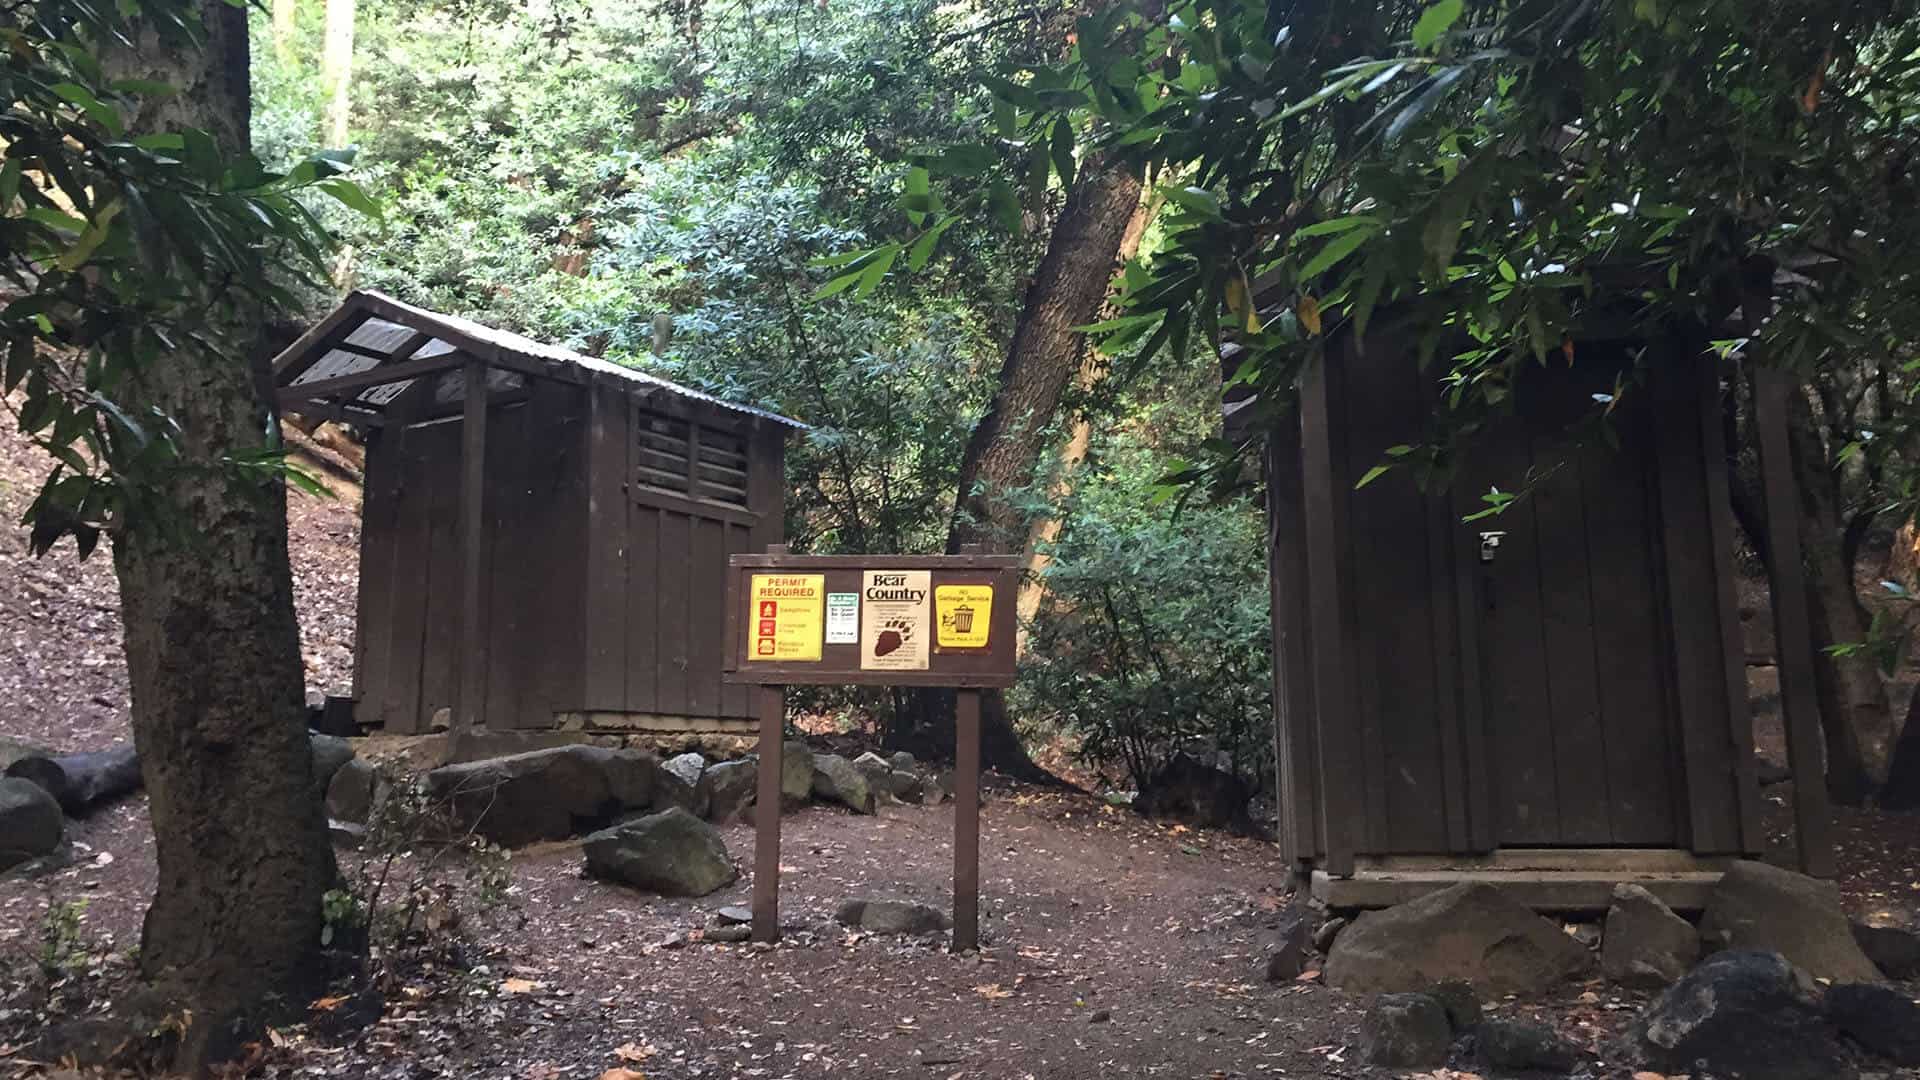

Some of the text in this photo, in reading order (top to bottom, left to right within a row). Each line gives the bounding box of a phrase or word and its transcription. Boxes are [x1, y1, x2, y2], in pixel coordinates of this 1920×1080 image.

[767, 578, 807, 587] PERMIT
[873, 574, 906, 587] Bear
[760, 587, 815, 597] REQUIRED
[866, 587, 927, 605] Country
